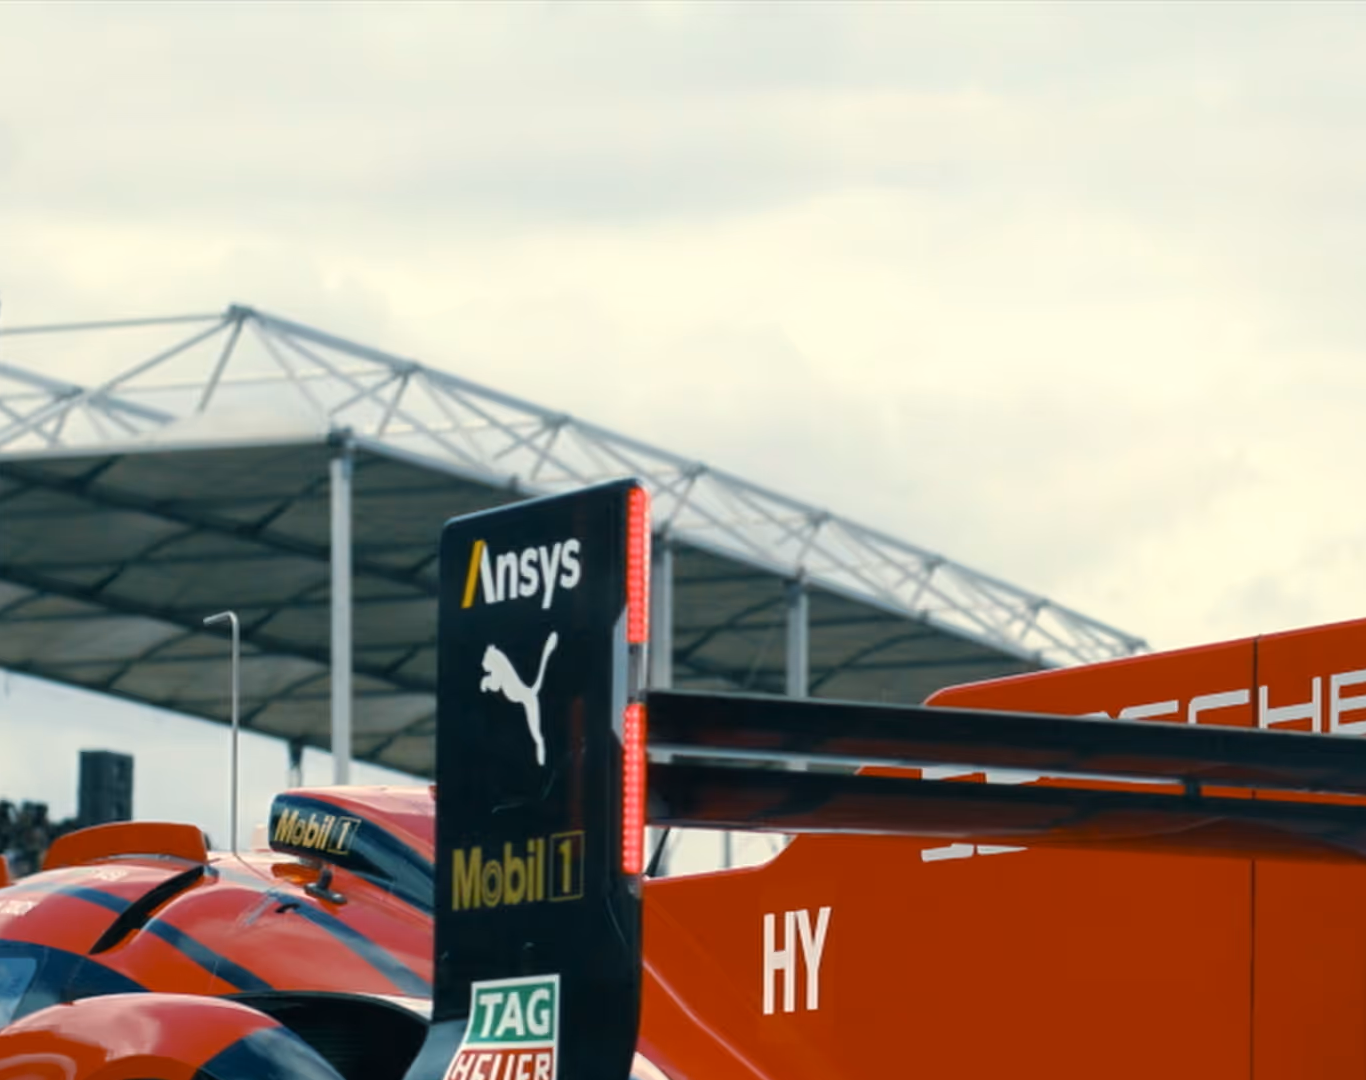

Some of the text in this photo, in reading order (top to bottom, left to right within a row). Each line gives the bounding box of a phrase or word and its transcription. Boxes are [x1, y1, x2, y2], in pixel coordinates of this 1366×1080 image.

[461, 539, 581, 609] Ansys
[275, 808, 336, 850] Mobil
[451, 838, 545, 911] Mobil
[763, 906, 832, 1015] HY
[478, 988, 552, 1038] TAG
